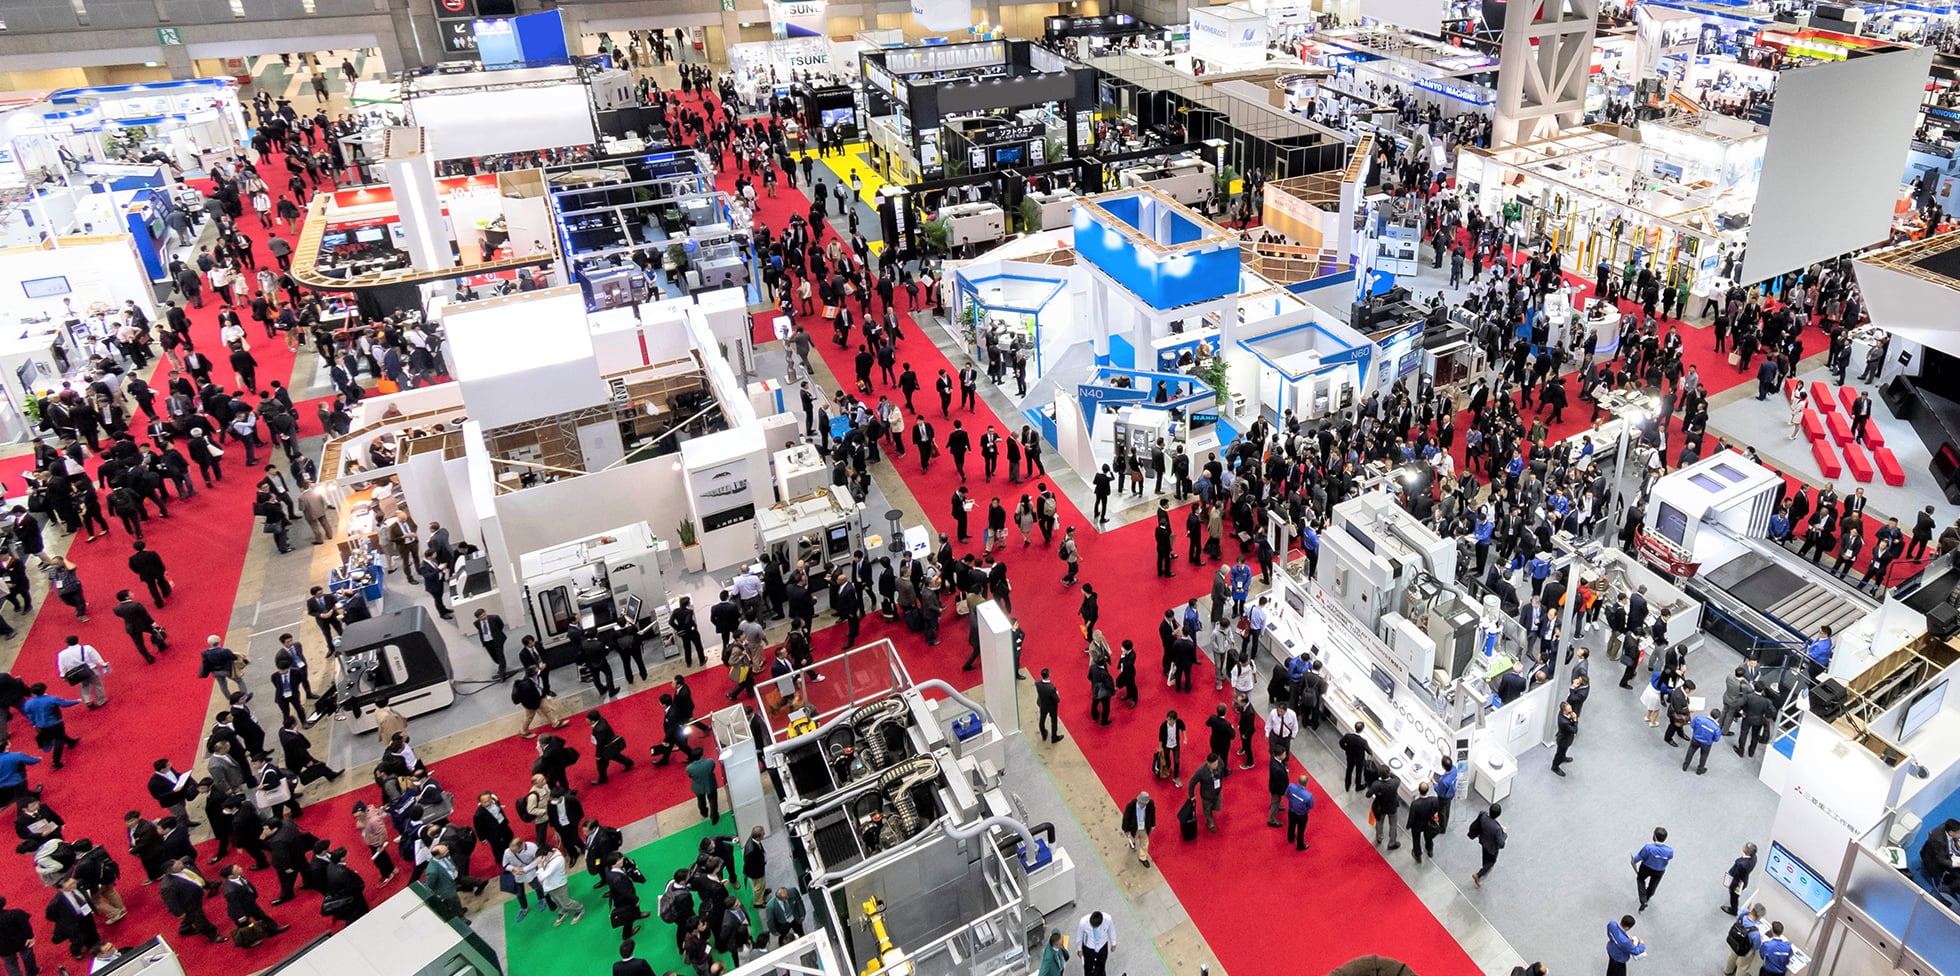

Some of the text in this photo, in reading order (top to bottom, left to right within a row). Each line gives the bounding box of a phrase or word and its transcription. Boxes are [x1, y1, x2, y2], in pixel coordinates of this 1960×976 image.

[790, 55, 829, 66] TSUNE
[1420, 79, 1477, 102] SANYO MACHINE
[1351, 346, 1370, 360] N60
[1079, 388, 1104, 399] N40
